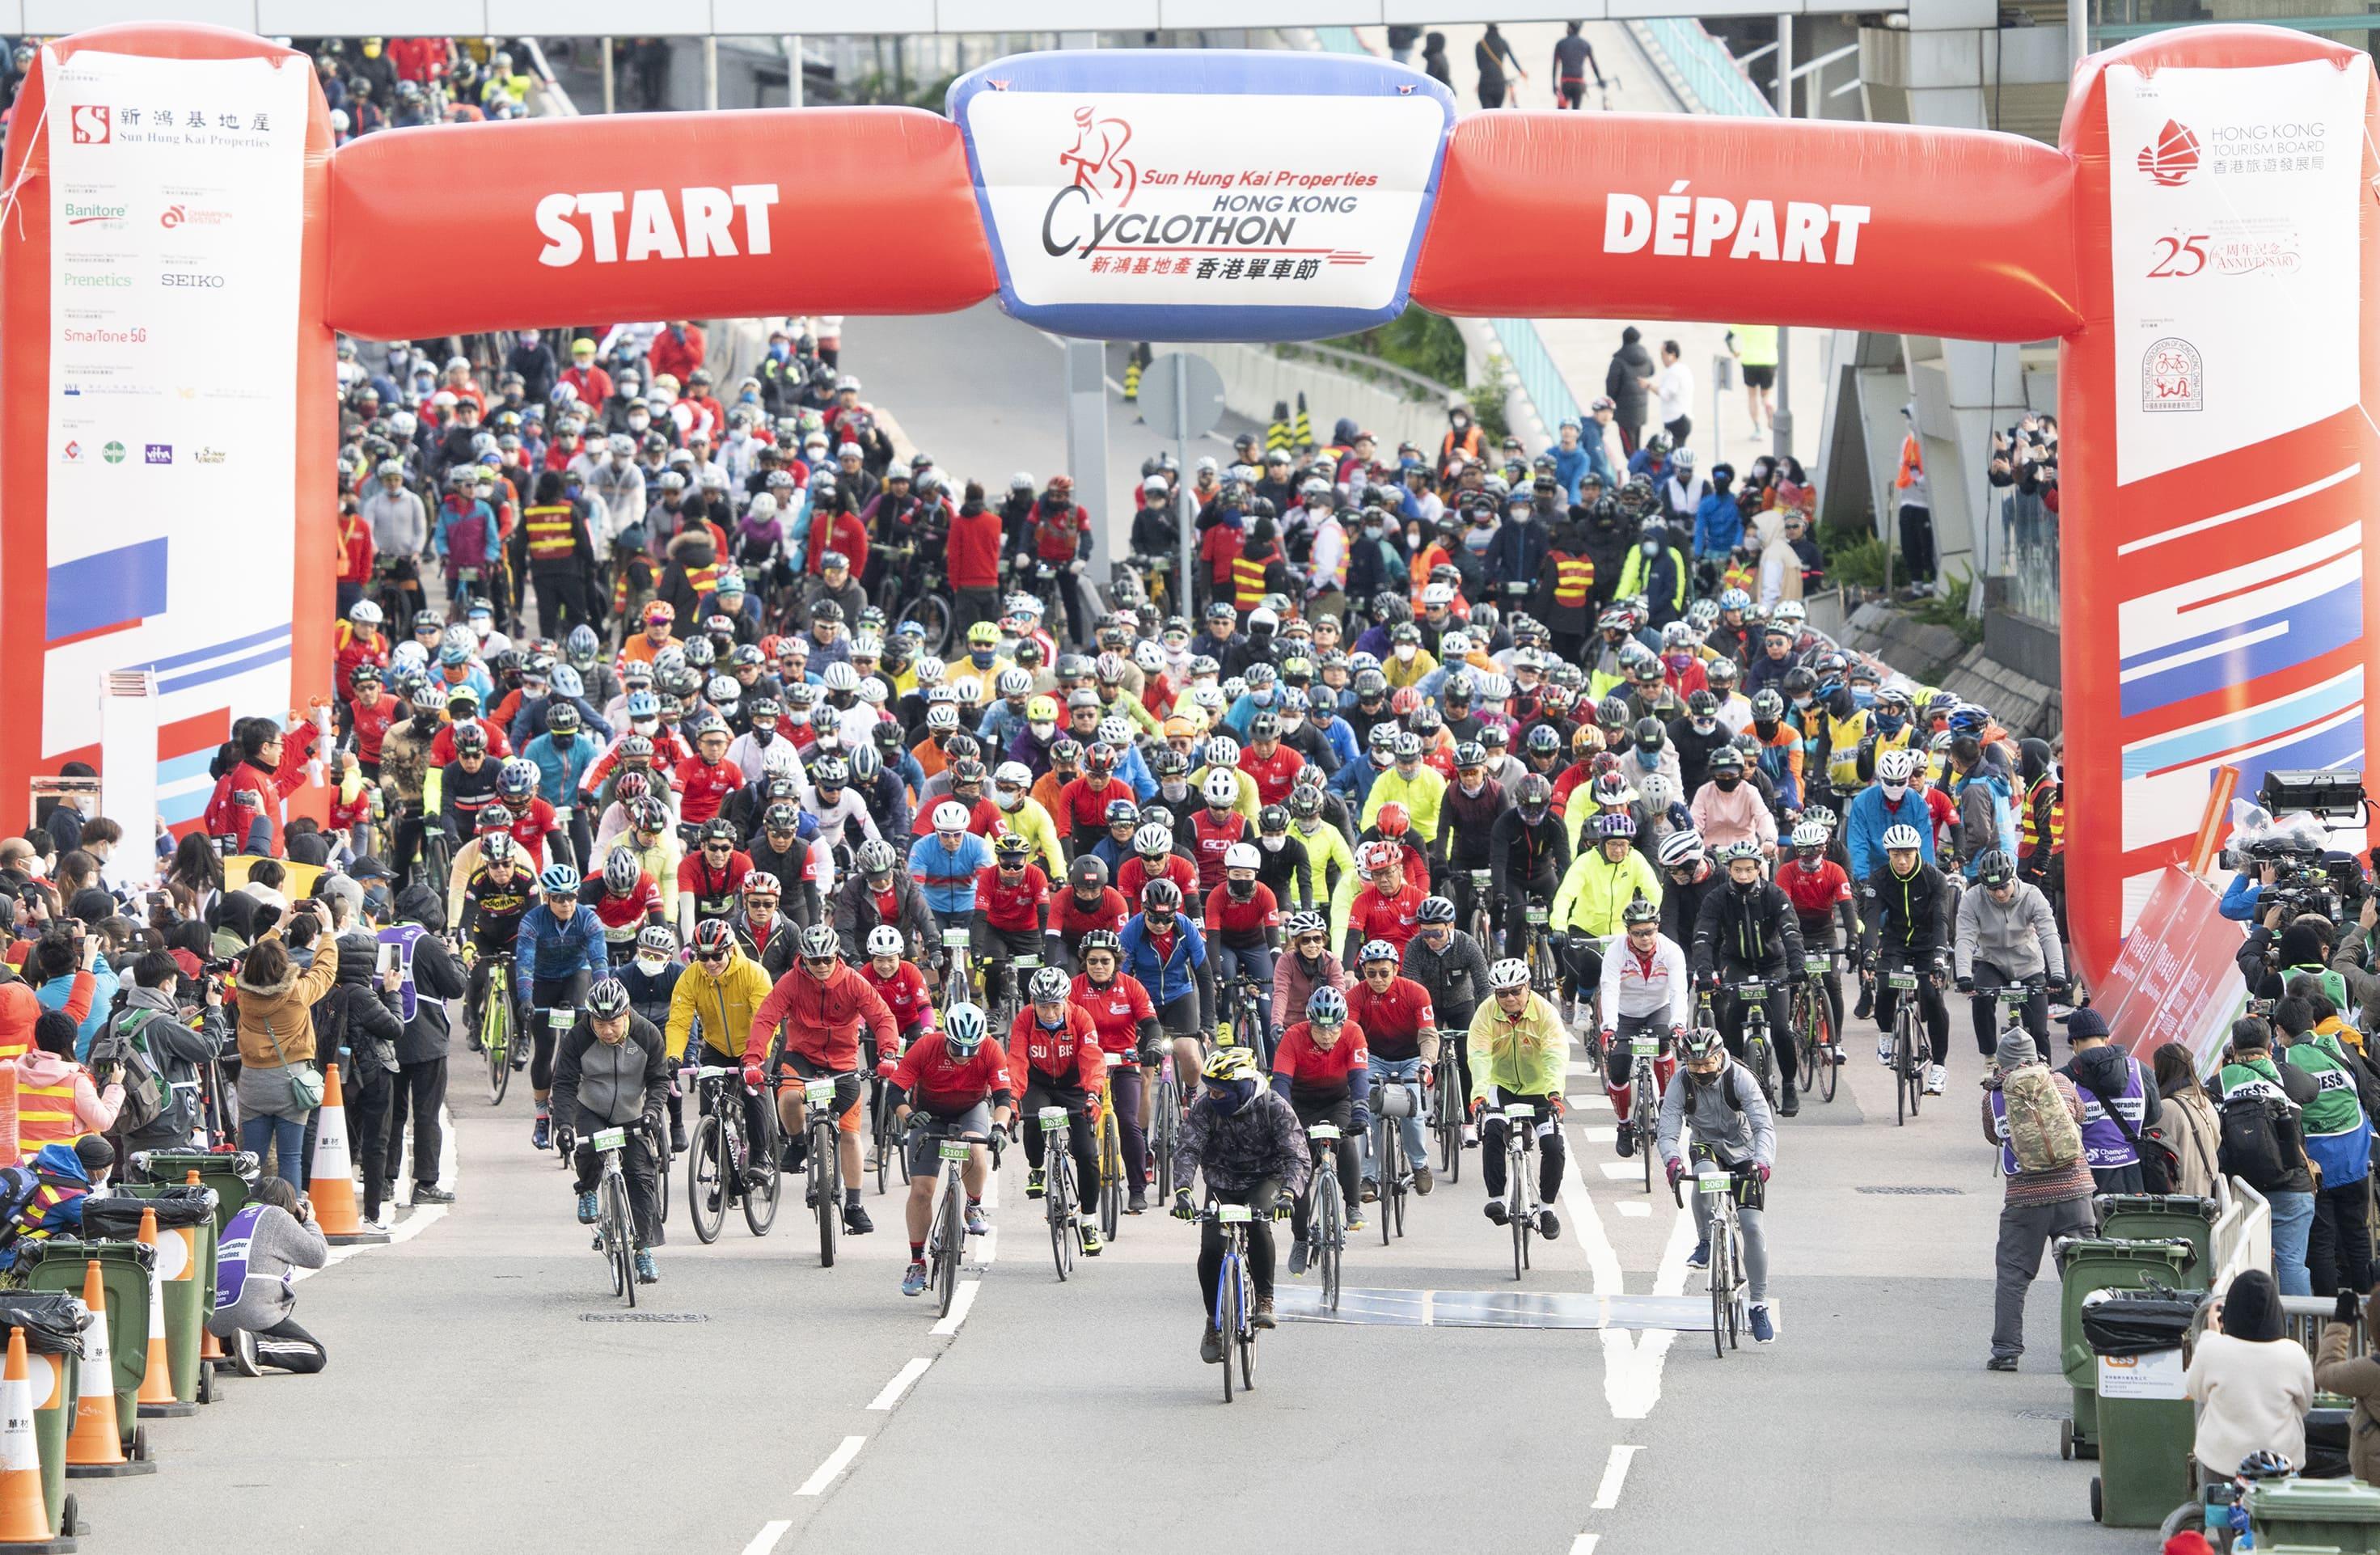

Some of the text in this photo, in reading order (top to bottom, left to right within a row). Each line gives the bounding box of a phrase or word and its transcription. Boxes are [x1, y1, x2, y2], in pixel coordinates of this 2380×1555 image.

[2212, 122, 2325, 142] HONG KONG
[119, 132, 271, 150] Sun Hung Kai Properties
[2213, 141, 2324, 156] TOURISM BOARD
[2213, 156, 2325, 175] 香港旅遊發展局
[1141, 170, 1378, 189] Sun Hung Kai Properties
[66, 203, 125, 217] Banitore
[1212, 195, 1359, 213] HONG KONG
[188, 209, 233, 219] CHAMPION
[535, 184, 780, 268] START
[1042, 185, 1296, 260] CYCLOTHON
[1603, 180, 1871, 266] DÉPART
[2145, 235, 2210, 278] 25
[2217, 256, 2295, 270] ANNIVERSARY
[1089, 256, 1321, 281] 新鴻基地產 香港單車節
[64, 273, 132, 287] Prenetics
[162, 273, 224, 288] SEIKO
[64, 327, 146, 343] SmarTone 5G
[1203, 839, 1238, 851] GCN
[1636, 1046, 1655, 1054] 5042
[810, 1088, 830, 1098] 5099
[1045, 1118, 1064, 1127] 5025
[599, 1136, 621, 1147] 5420
[944, 1148, 964, 1157] 5101
[1704, 1180, 1724, 1189] 5067
